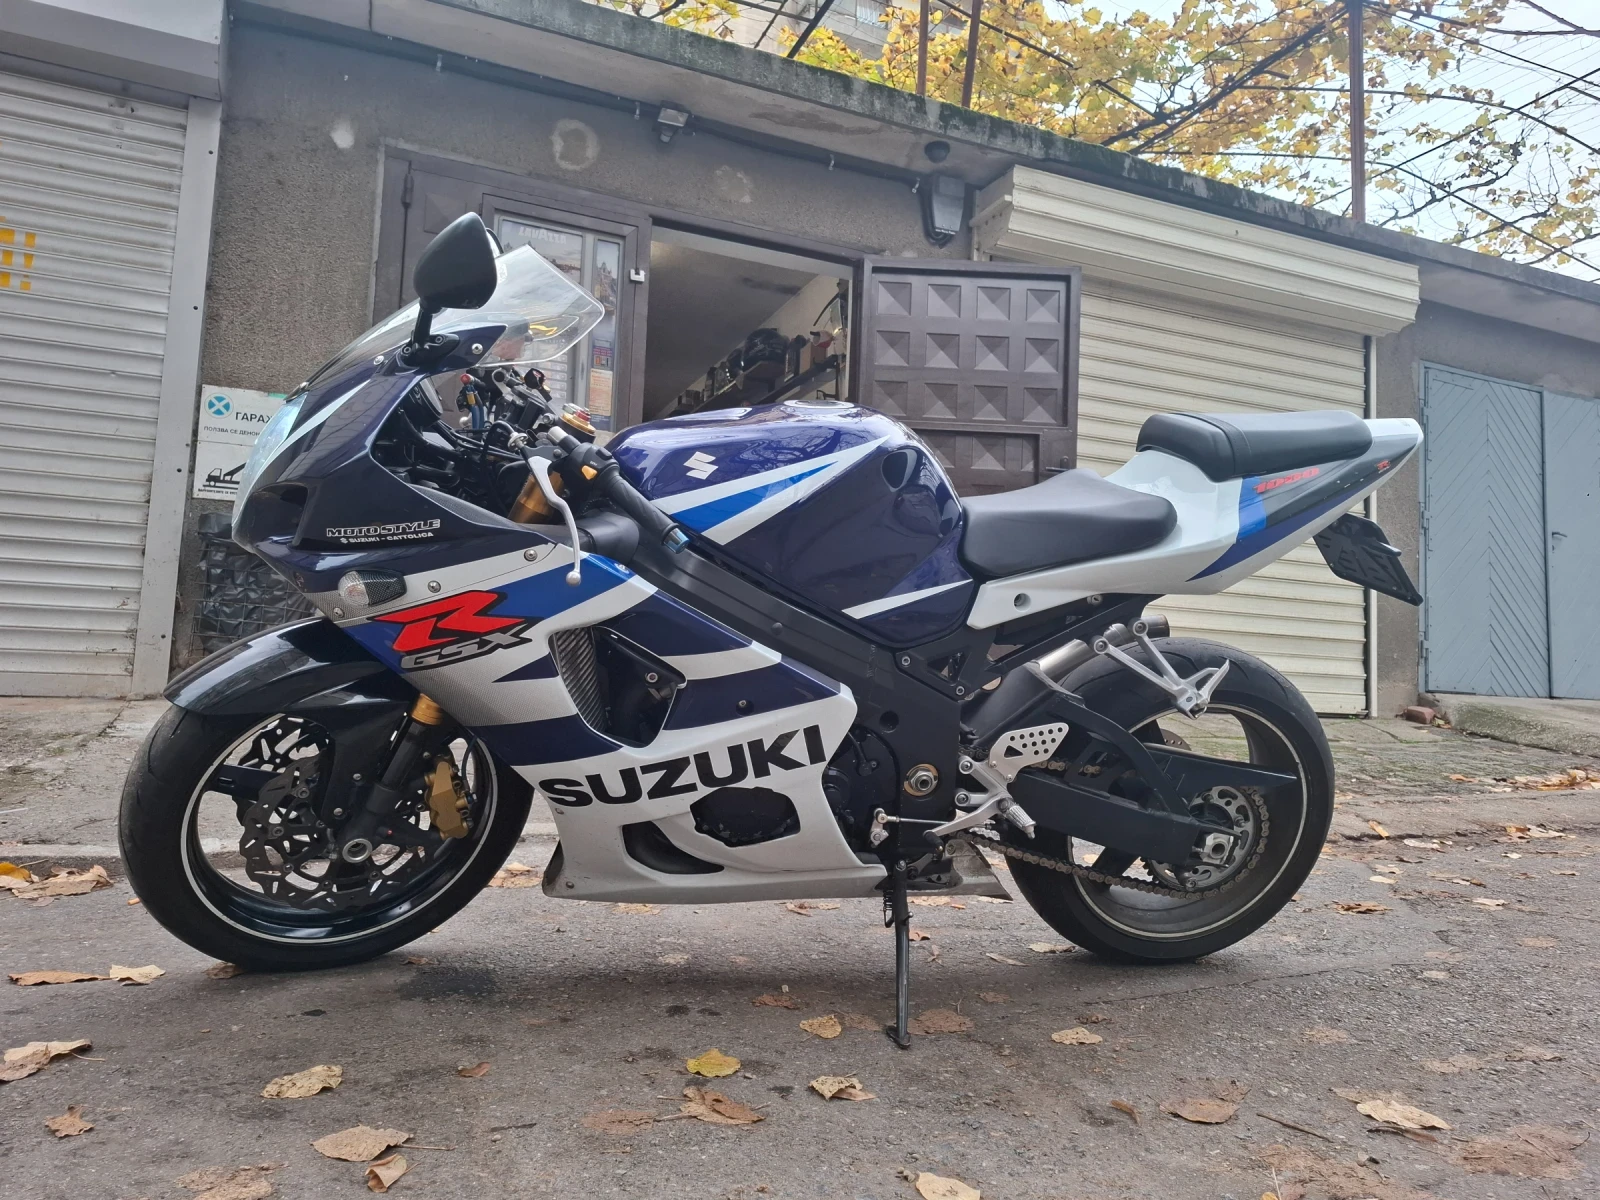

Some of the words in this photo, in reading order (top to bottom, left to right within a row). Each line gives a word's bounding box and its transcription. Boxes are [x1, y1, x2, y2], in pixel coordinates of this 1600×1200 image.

[518, 226, 567, 245] LAVAZZA
[349, 536, 381, 544] SUZUKI
[386, 531, 434, 541] CATTOLICA
[369, 590, 531, 653] R
[400, 623, 531, 670] GSX
[538, 724, 827, 808] SUZUKI
